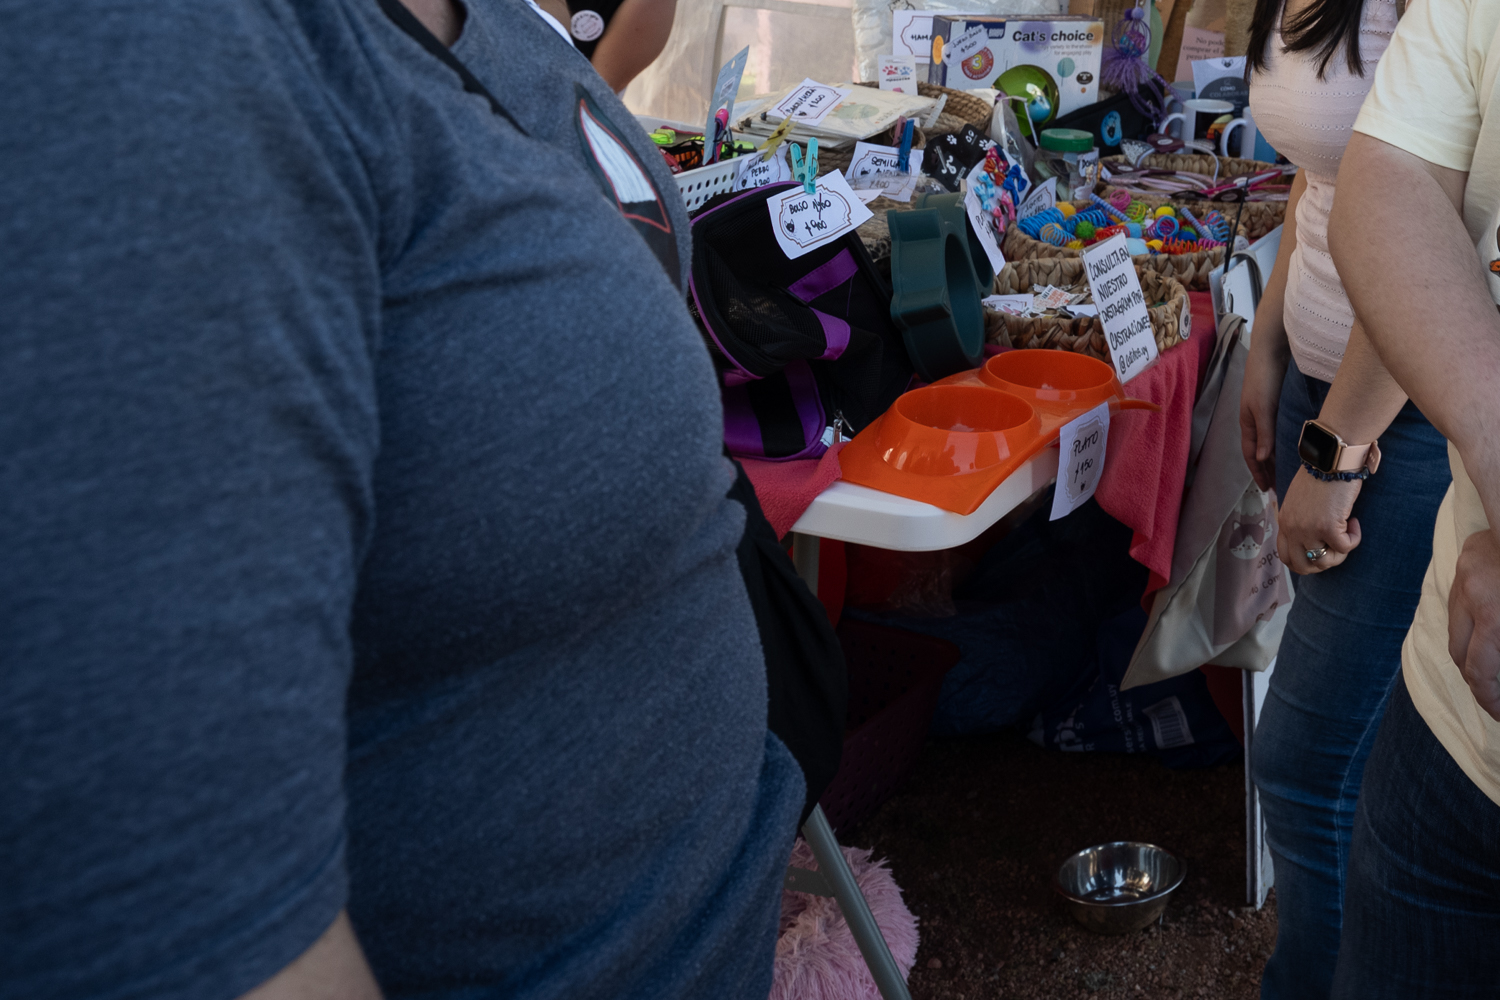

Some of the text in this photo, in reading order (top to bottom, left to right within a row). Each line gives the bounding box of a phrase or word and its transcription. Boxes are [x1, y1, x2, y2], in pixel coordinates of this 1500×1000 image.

[1012, 29, 1094, 42] Cat's choice
[972, 54, 984, 71] 3
[789, 200, 809, 215] BOLSO
[1097, 272, 1128, 302] NUESTRO
[1101, 292, 1132, 324] INSTAGRAM
[1109, 314, 1152, 351] CASTRACIONES
[1073, 430, 1099, 457] PLATO
